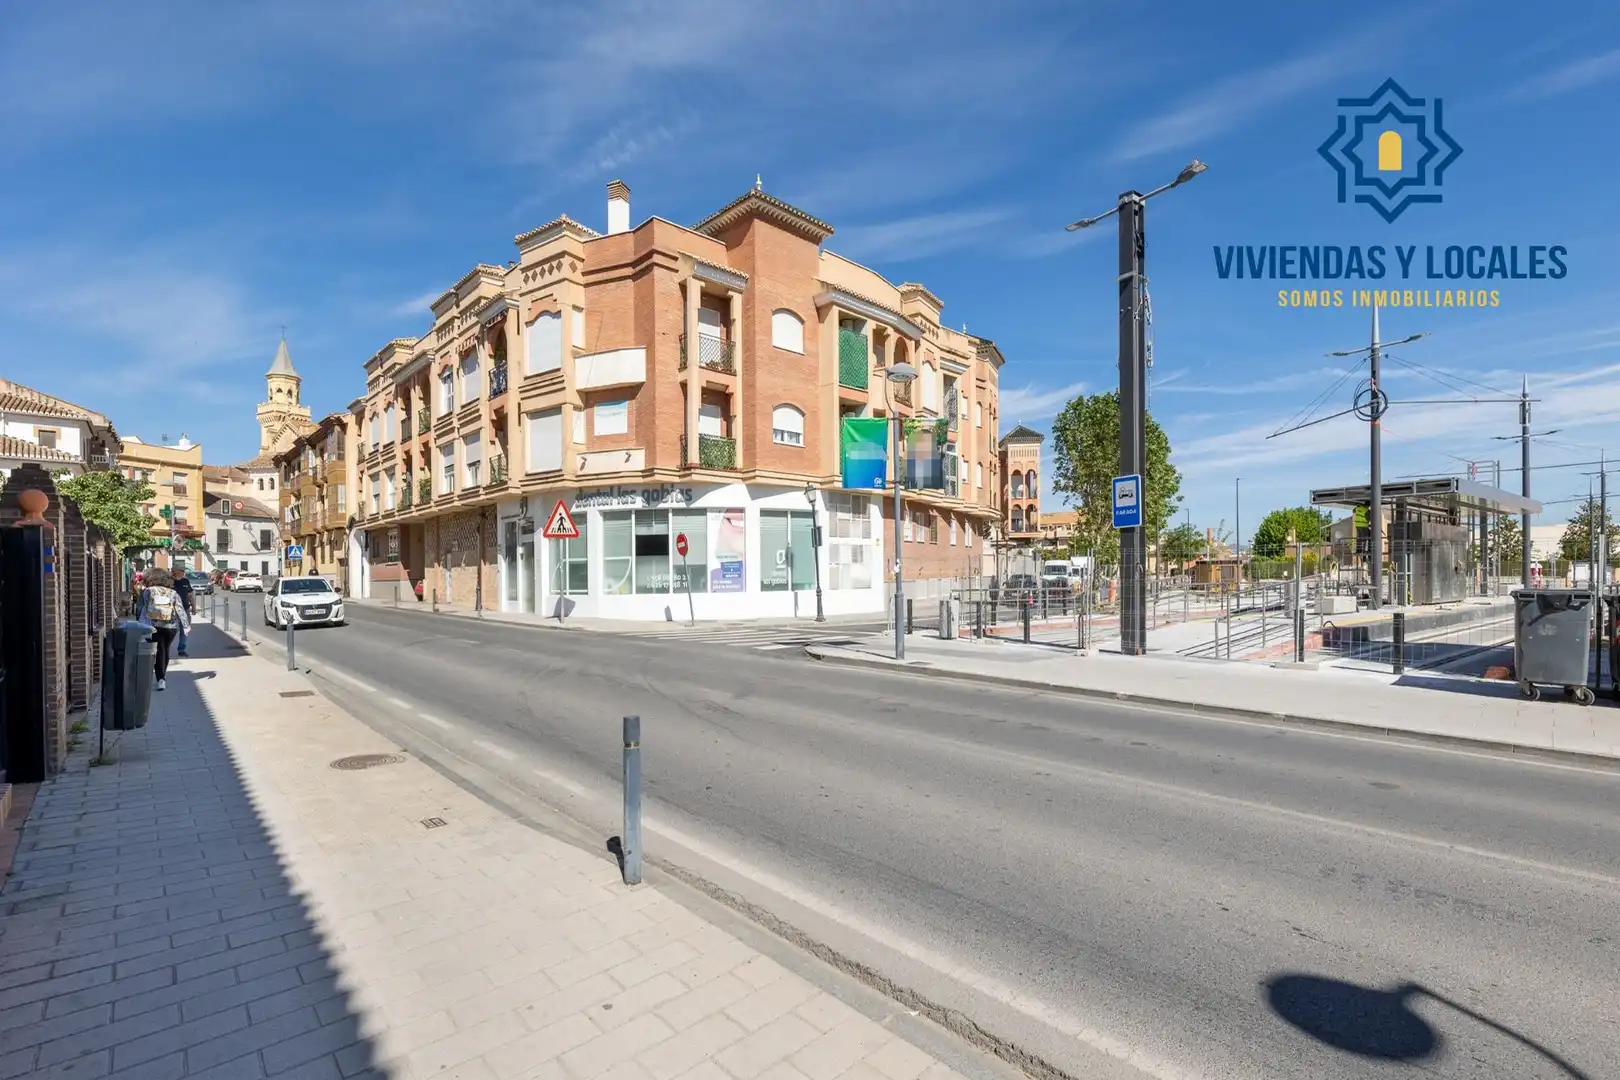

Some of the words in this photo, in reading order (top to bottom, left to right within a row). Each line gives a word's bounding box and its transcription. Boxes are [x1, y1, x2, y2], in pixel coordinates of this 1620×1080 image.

[574, 485, 612, 509] dental
[616, 484, 638, 505] las
[641, 483, 693, 506] gabias
[1115, 508, 1137, 516] PARADA
